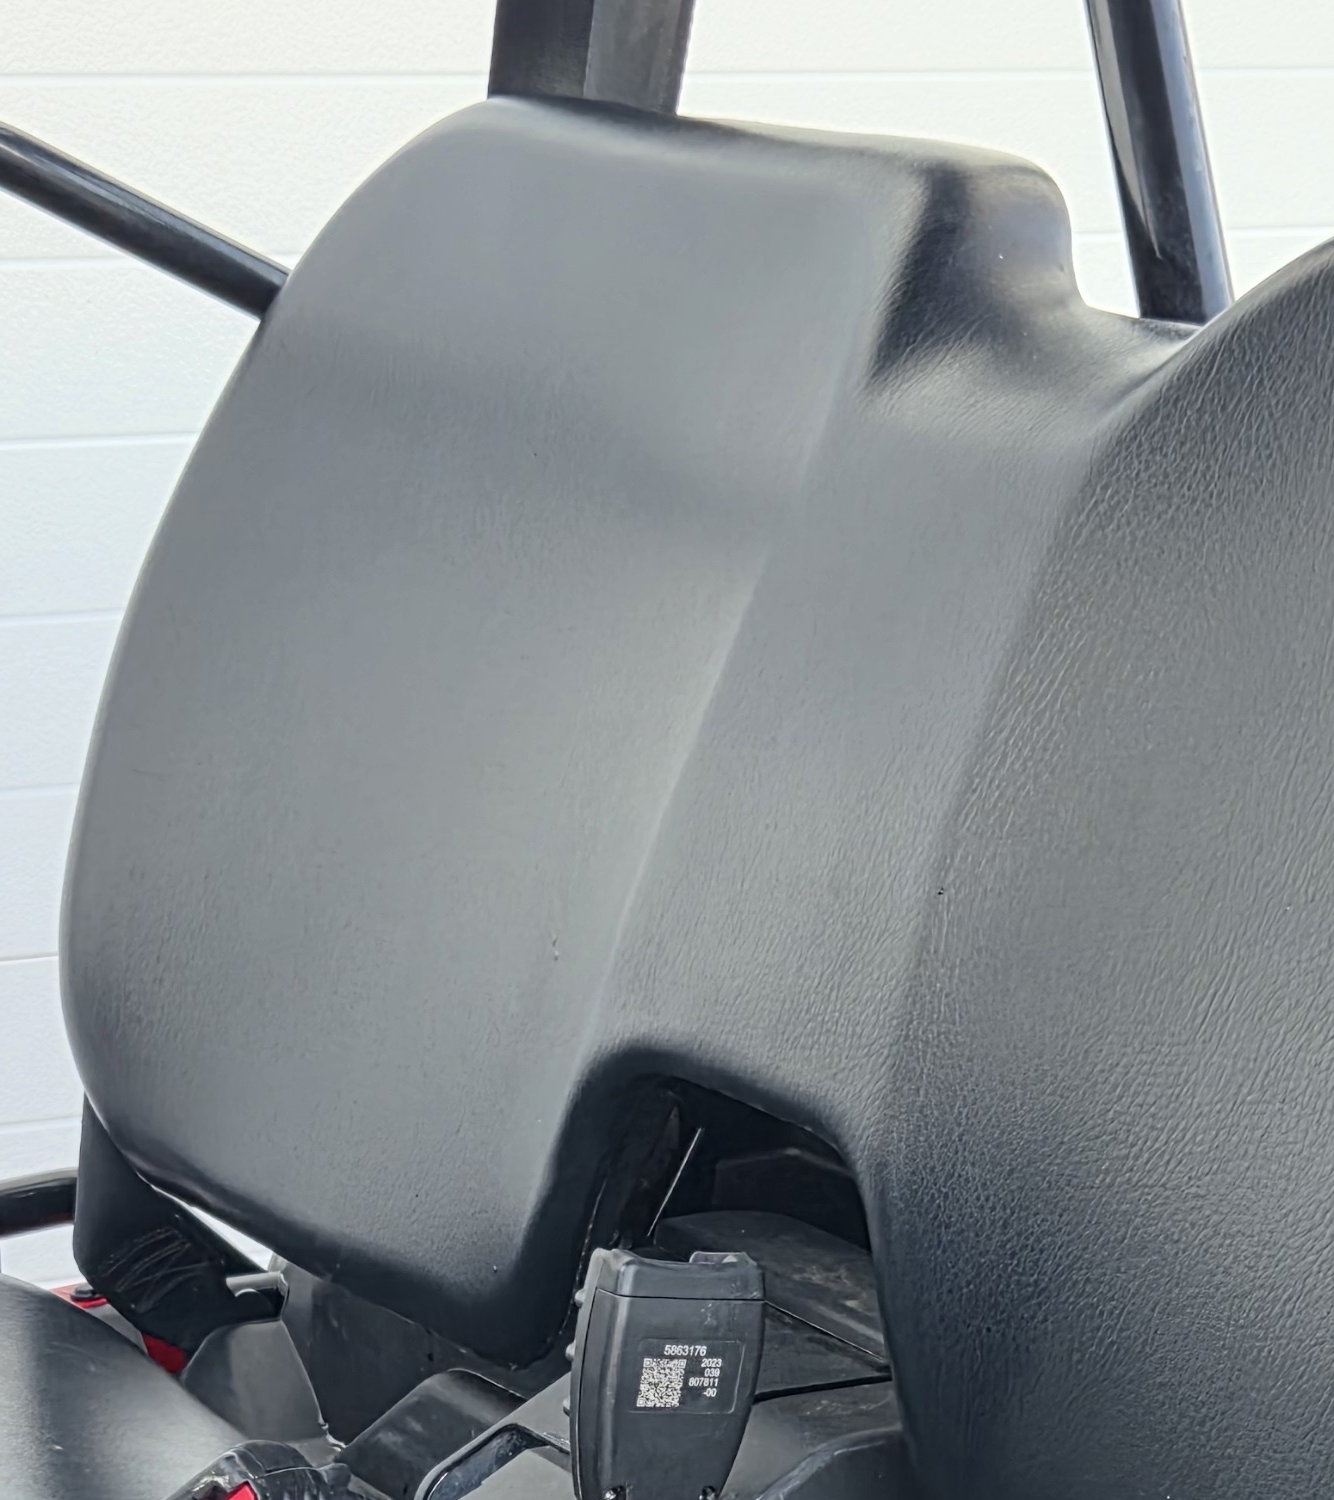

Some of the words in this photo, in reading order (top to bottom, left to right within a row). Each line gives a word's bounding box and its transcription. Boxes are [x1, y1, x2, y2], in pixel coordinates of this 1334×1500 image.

[664, 1345, 707, 1356] 5863176
[701, 1358, 722, 1367] 2023
[704, 1368, 720, 1377] 039
[703, 1388, 717, 1397] -00
